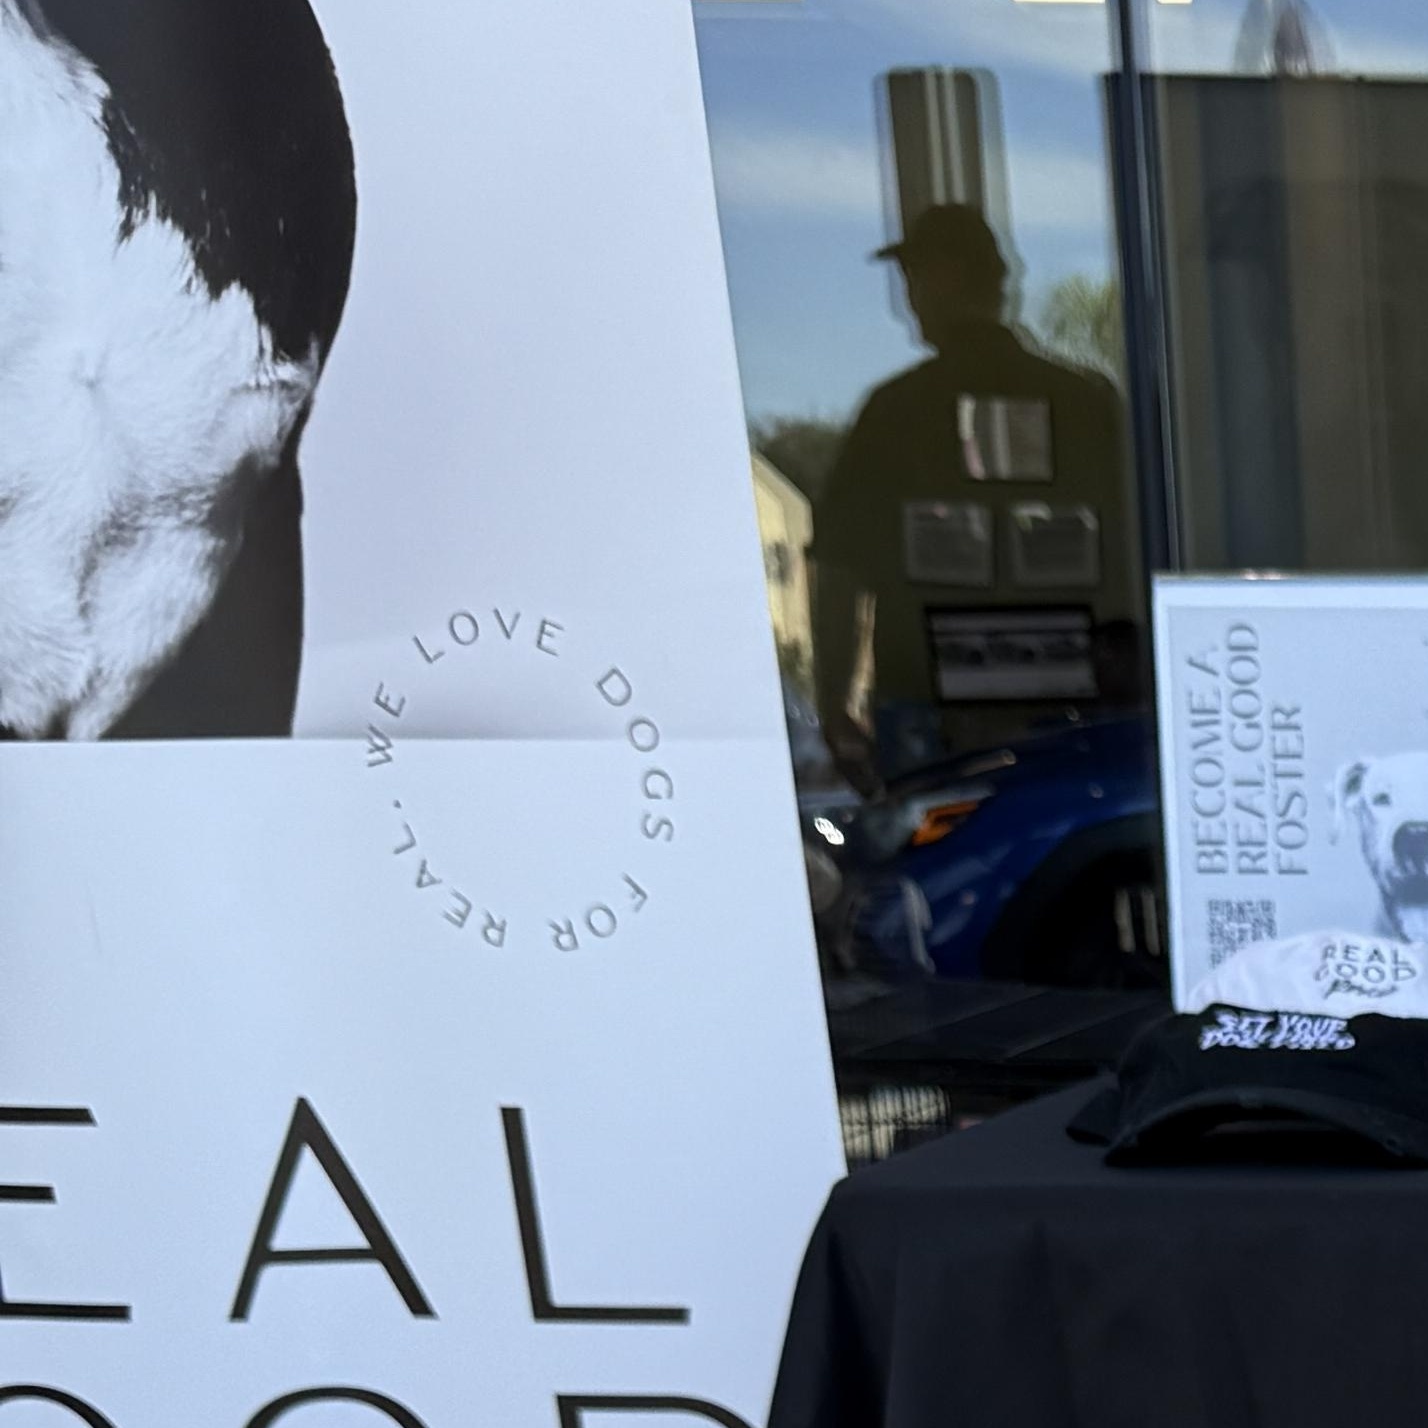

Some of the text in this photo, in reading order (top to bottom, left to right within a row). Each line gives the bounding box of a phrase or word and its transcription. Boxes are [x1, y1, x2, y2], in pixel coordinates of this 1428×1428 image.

[412, 607, 564, 664] LOVE
[363, 681, 406, 767] WE
[596, 666, 674, 842] DOGS
[1188, 688, 1229, 875] BECOME
[1226, 621, 1270, 875] REAL GOOD
[1270, 704, 1309, 876] FOSTER
[549, 873, 648, 952] FOR
[1321, 944, 1411, 966] REAL
